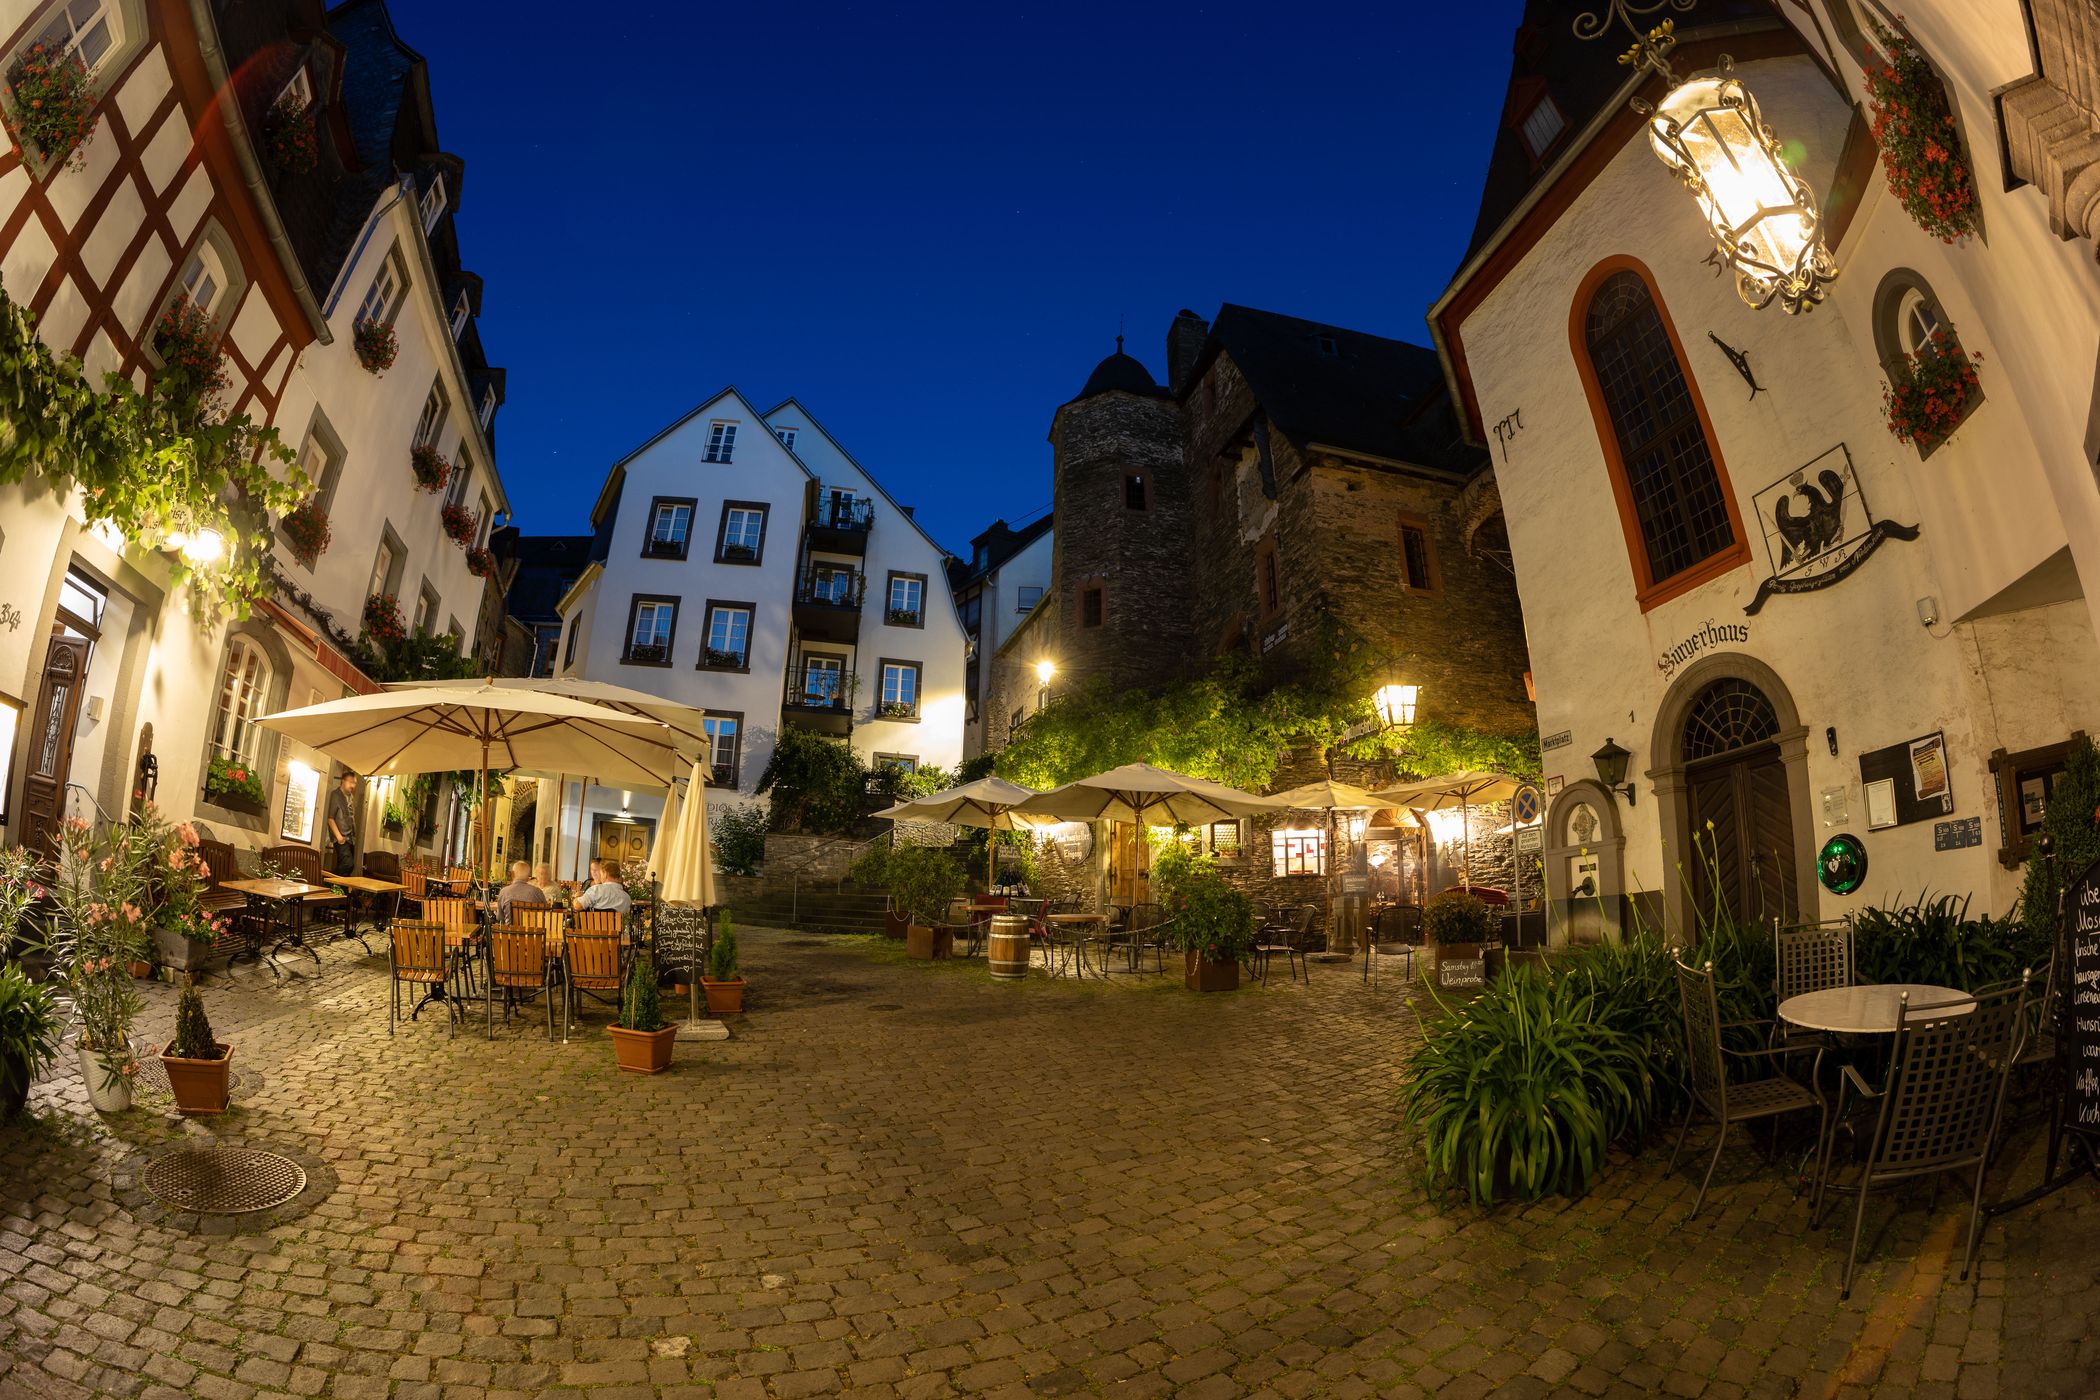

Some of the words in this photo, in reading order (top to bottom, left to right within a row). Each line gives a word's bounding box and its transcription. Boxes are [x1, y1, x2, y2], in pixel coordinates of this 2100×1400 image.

[1657, 618, 1752, 682] Bürgerhaus
[1628, 710, 1635, 724] 1
[1543, 734, 1569, 749] Marktplatz
[2075, 908, 2100, 933] Mos
[1441, 972, 1483, 987] Weinprobe
